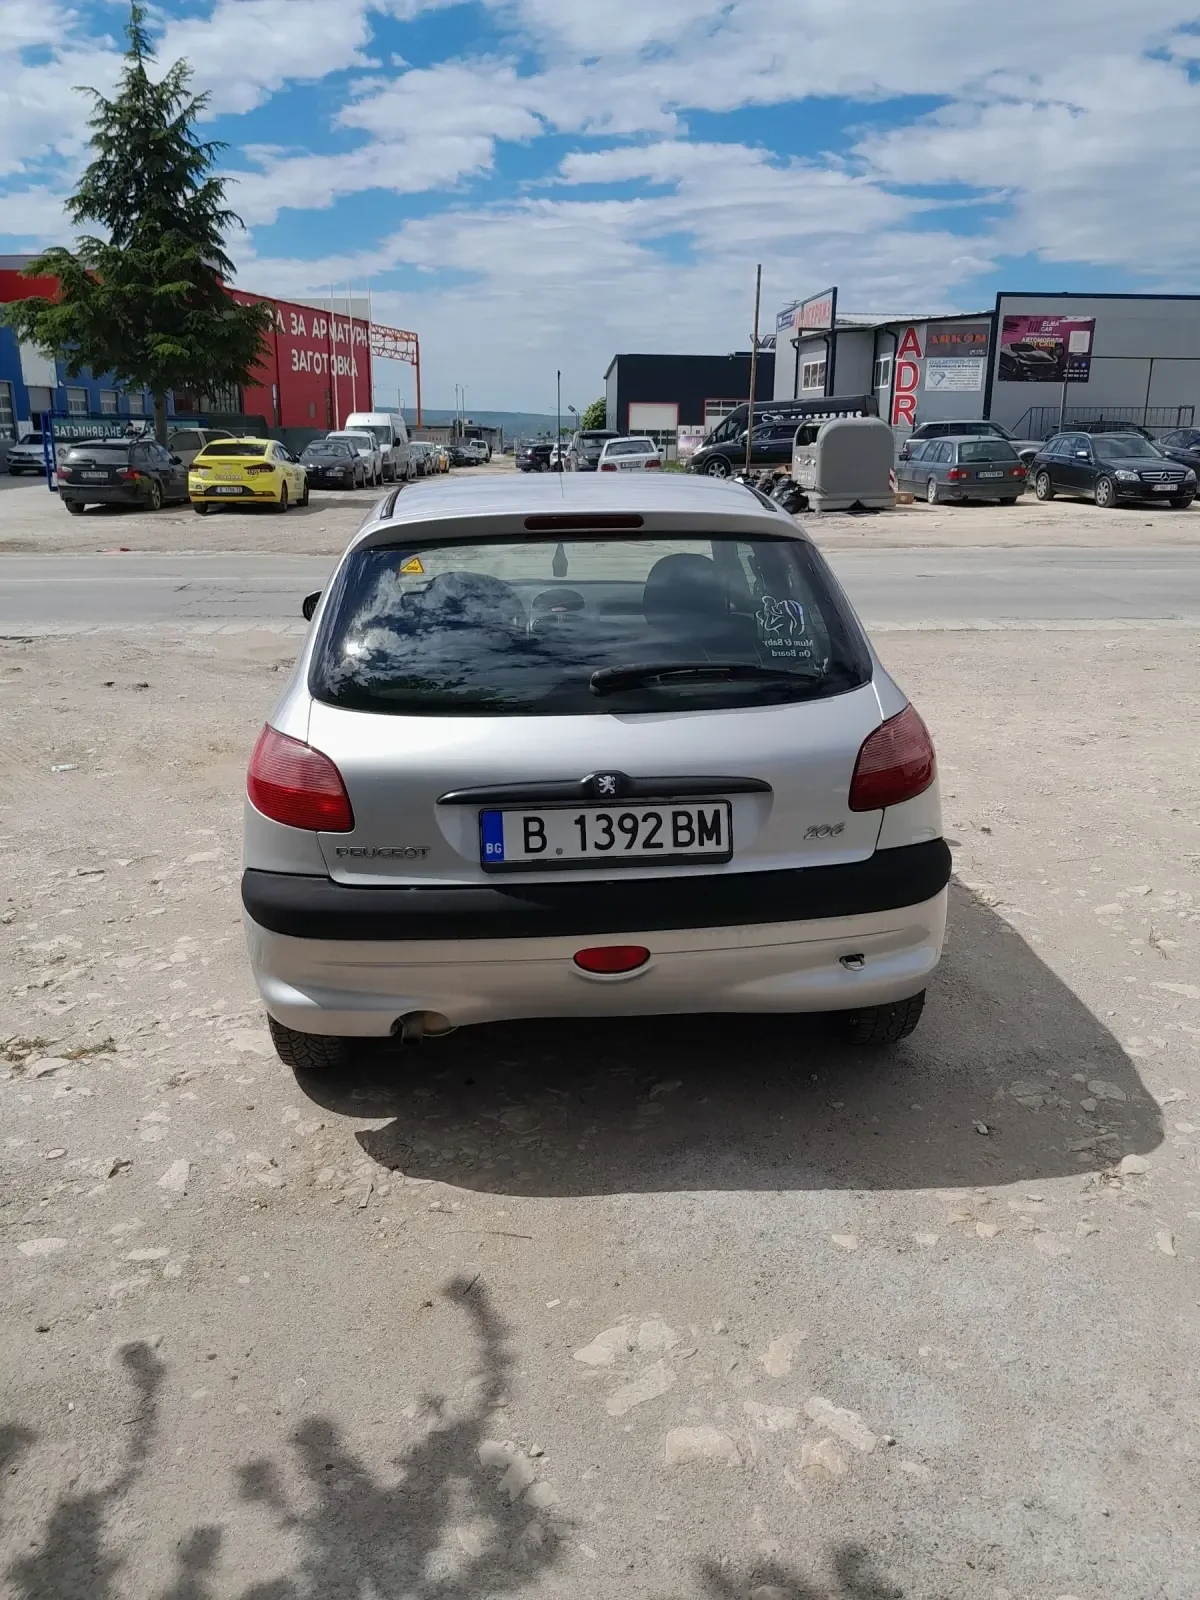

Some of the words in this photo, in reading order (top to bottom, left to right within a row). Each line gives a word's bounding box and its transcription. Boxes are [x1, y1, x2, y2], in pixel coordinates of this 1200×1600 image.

[290, 312, 307, 336] ЗА
[312, 317, 371, 347] АРМАТУРН
[291, 349, 359, 377] ЗАГОТОВКА
[889, 327, 924, 427] ADR
[54, 425, 122, 437] ЗАТЪМНЯВАНЕ
[522, 816, 548, 853] B
[574, 811, 664, 852] 1392
[671, 808, 722, 848] BM
[803, 821, 846, 840] 206
[335, 845, 431, 860] PEUGEOT
[486, 842, 502, 854] BG
